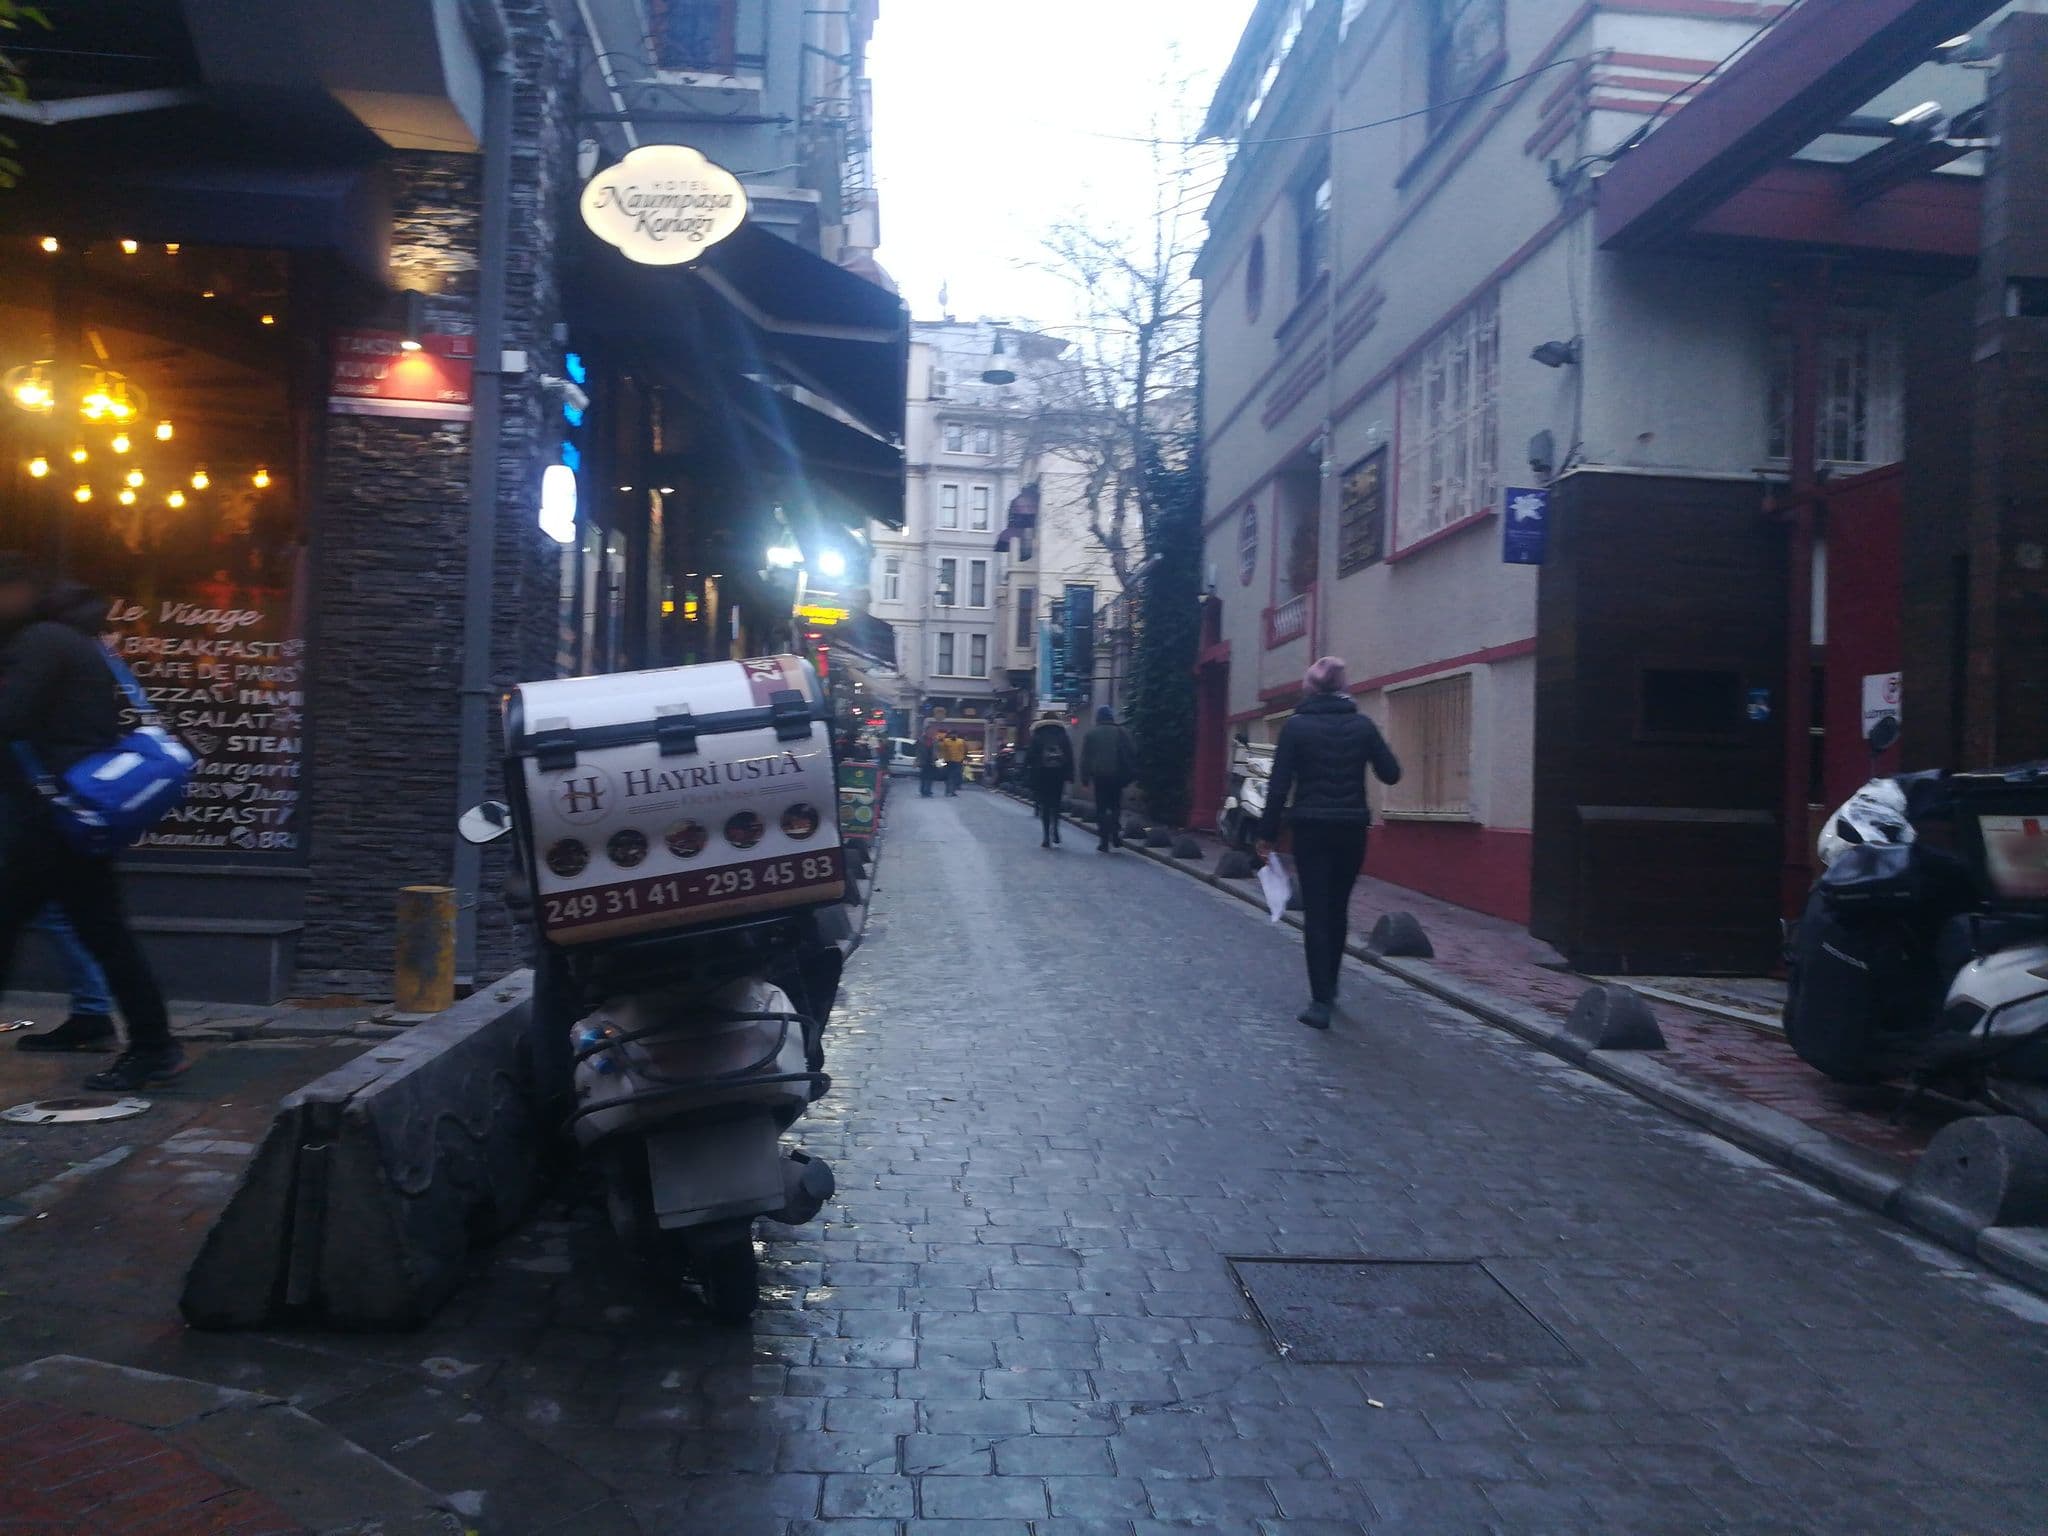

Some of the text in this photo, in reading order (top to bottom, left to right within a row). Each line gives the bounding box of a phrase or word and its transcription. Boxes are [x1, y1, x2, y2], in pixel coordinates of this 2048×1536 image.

[106, 598, 264, 633] Le Visage
[124, 636, 281, 658] BREAKFAST
[130, 660, 297, 682] CAFE DE PARIS
[113, 683, 211, 704] PIZZA
[176, 709, 275, 729] SALAT
[725, 752, 804, 782] USTA
[563, 775, 605, 814] H
[547, 894, 598, 923] 249
[606, 886, 638, 914] 31
[648, 880, 680, 906] 41
[707, 868, 755, 897] 293
[763, 861, 795, 886] 45
[802, 855, 833, 879] 83
